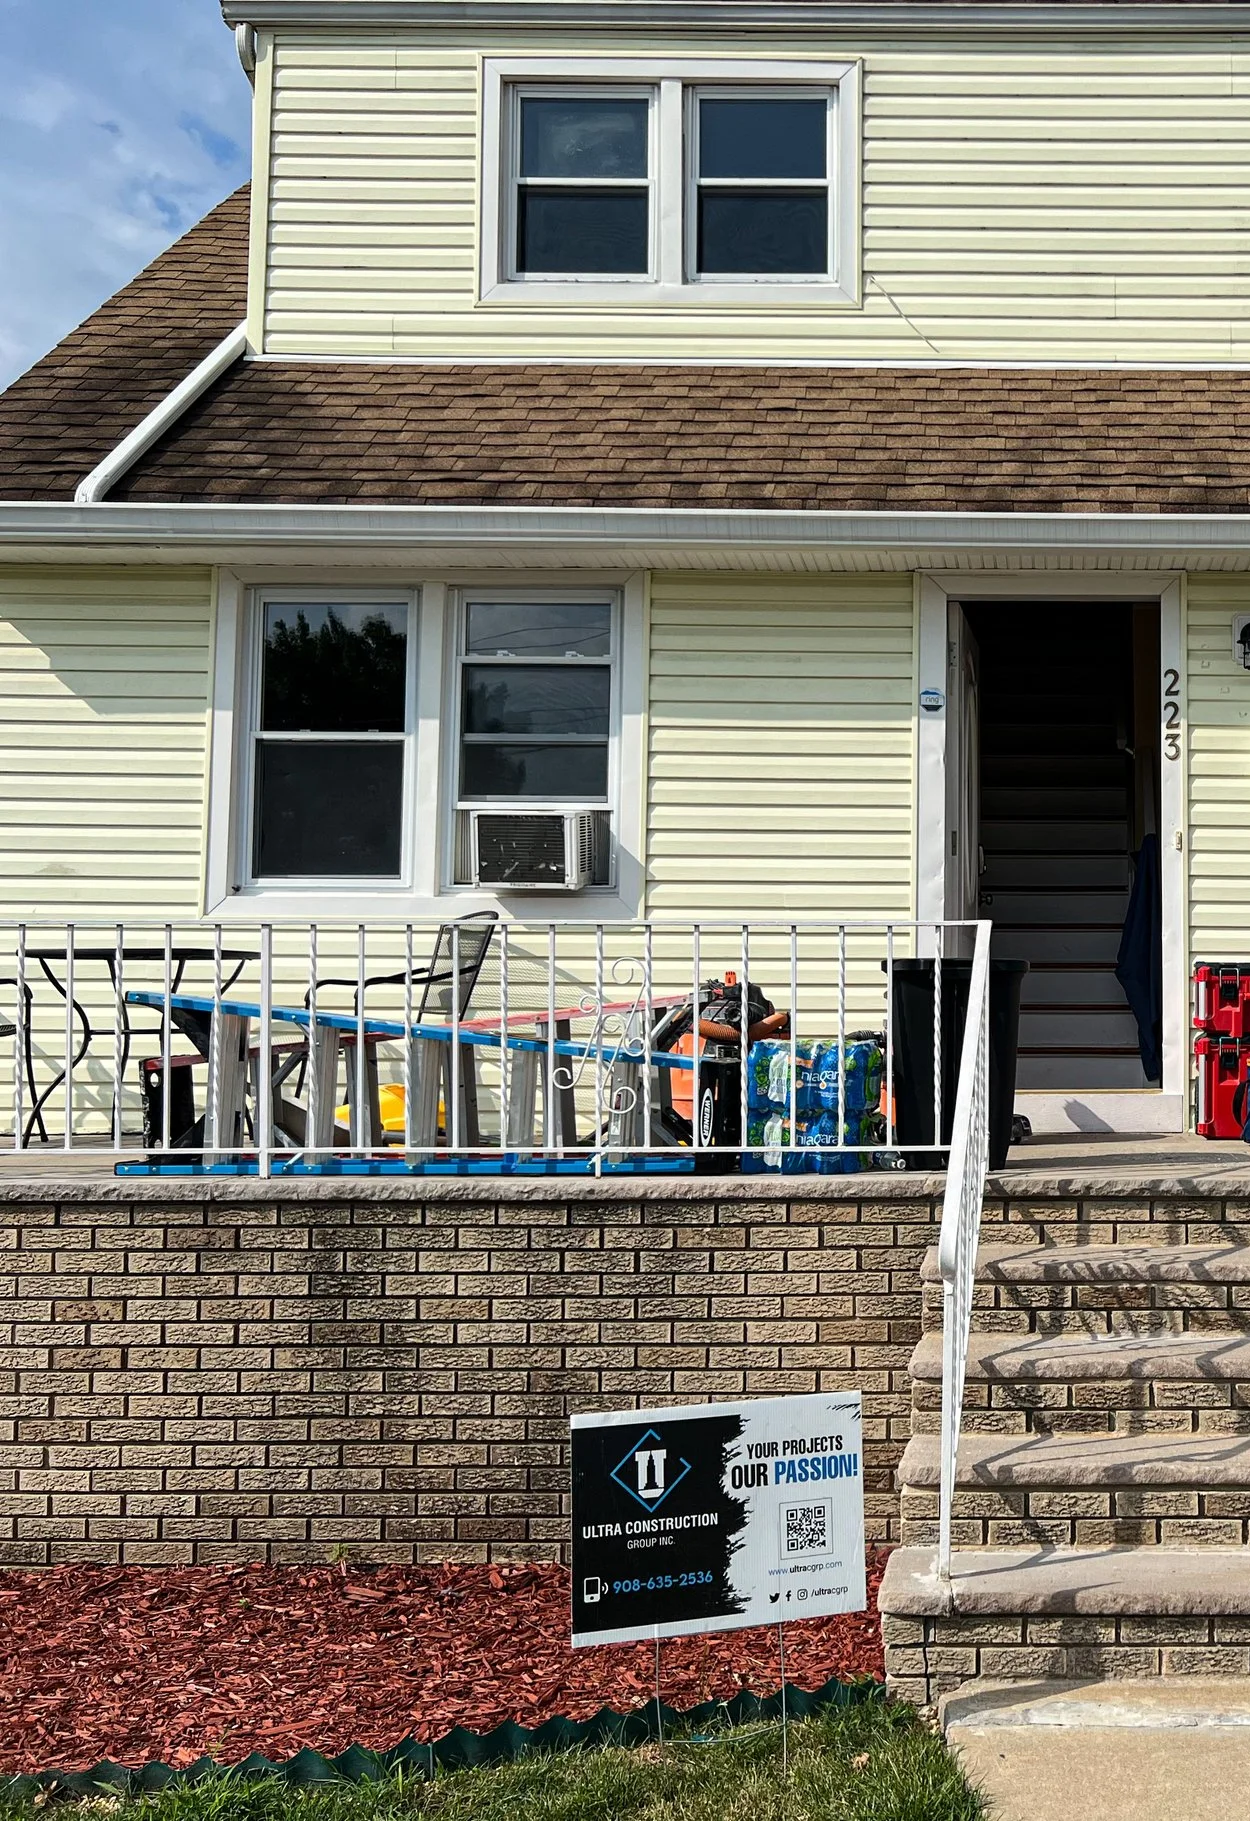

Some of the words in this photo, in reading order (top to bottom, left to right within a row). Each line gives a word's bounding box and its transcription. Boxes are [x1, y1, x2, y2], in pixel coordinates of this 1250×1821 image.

[925, 696, 940, 704] ring
[1164, 669, 1180, 760] 223
[801, 1071, 846, 1088] niagar
[703, 1100, 711, 1137] WERNER
[747, 1441, 779, 1460] YOUR
[782, 1435, 843, 1457] PROJECTS
[731, 1462, 769, 1490] OUR
[774, 1453, 859, 1485] PASSION!
[582, 1518, 622, 1539] ULTRA
[625, 1512, 719, 1535] CONSTRUCTION
[627, 1538, 657, 1550] GROUP
[659, 1536, 676, 1546] INC.
[768, 1560, 843, 1576] www.ultracgrp.com
[613, 1570, 713, 1594] 908-635-2536
[811, 1585, 849, 1598] /ultracgrp
